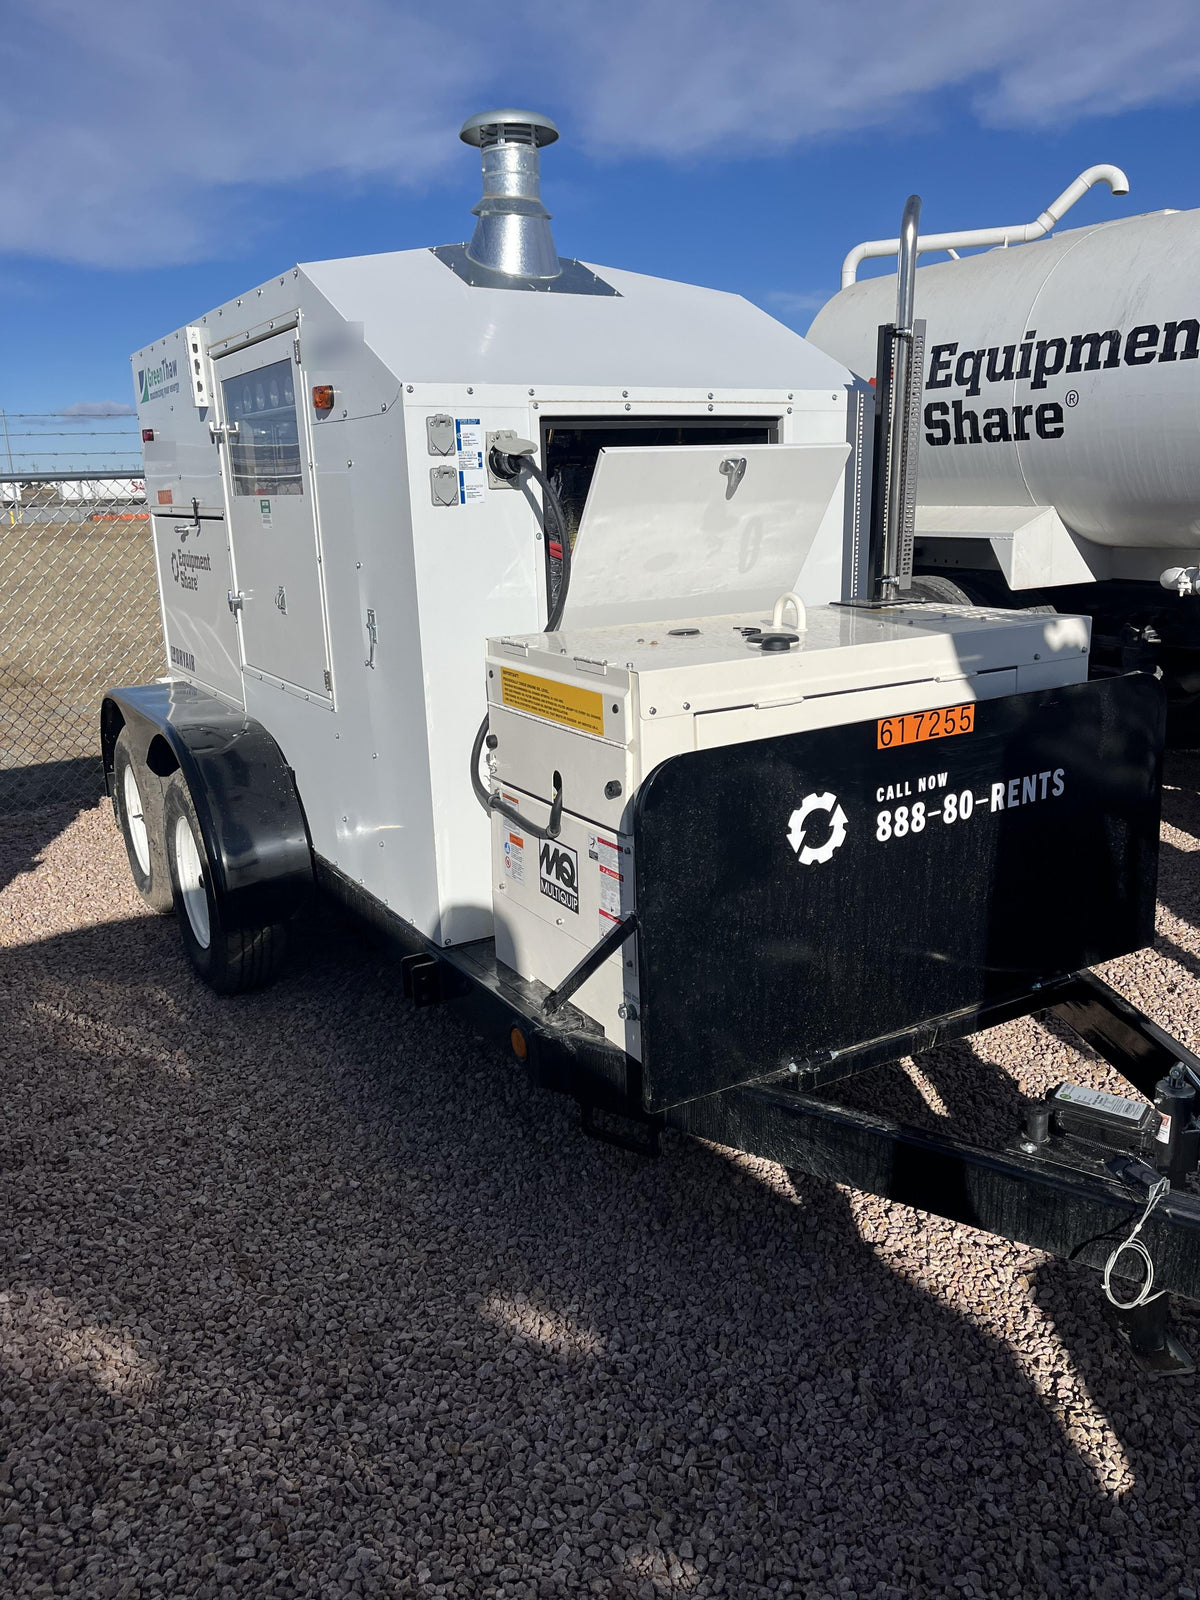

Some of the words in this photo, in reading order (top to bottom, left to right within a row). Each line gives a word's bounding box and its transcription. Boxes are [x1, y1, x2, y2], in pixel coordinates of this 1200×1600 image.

[178, 549, 211, 572] Equipment
[880, 706, 972, 746] 617255
[876, 781, 912, 802] CALL
[918, 771, 949, 793] NOW
[875, 768, 1065, 842] 888-80-RENTS
